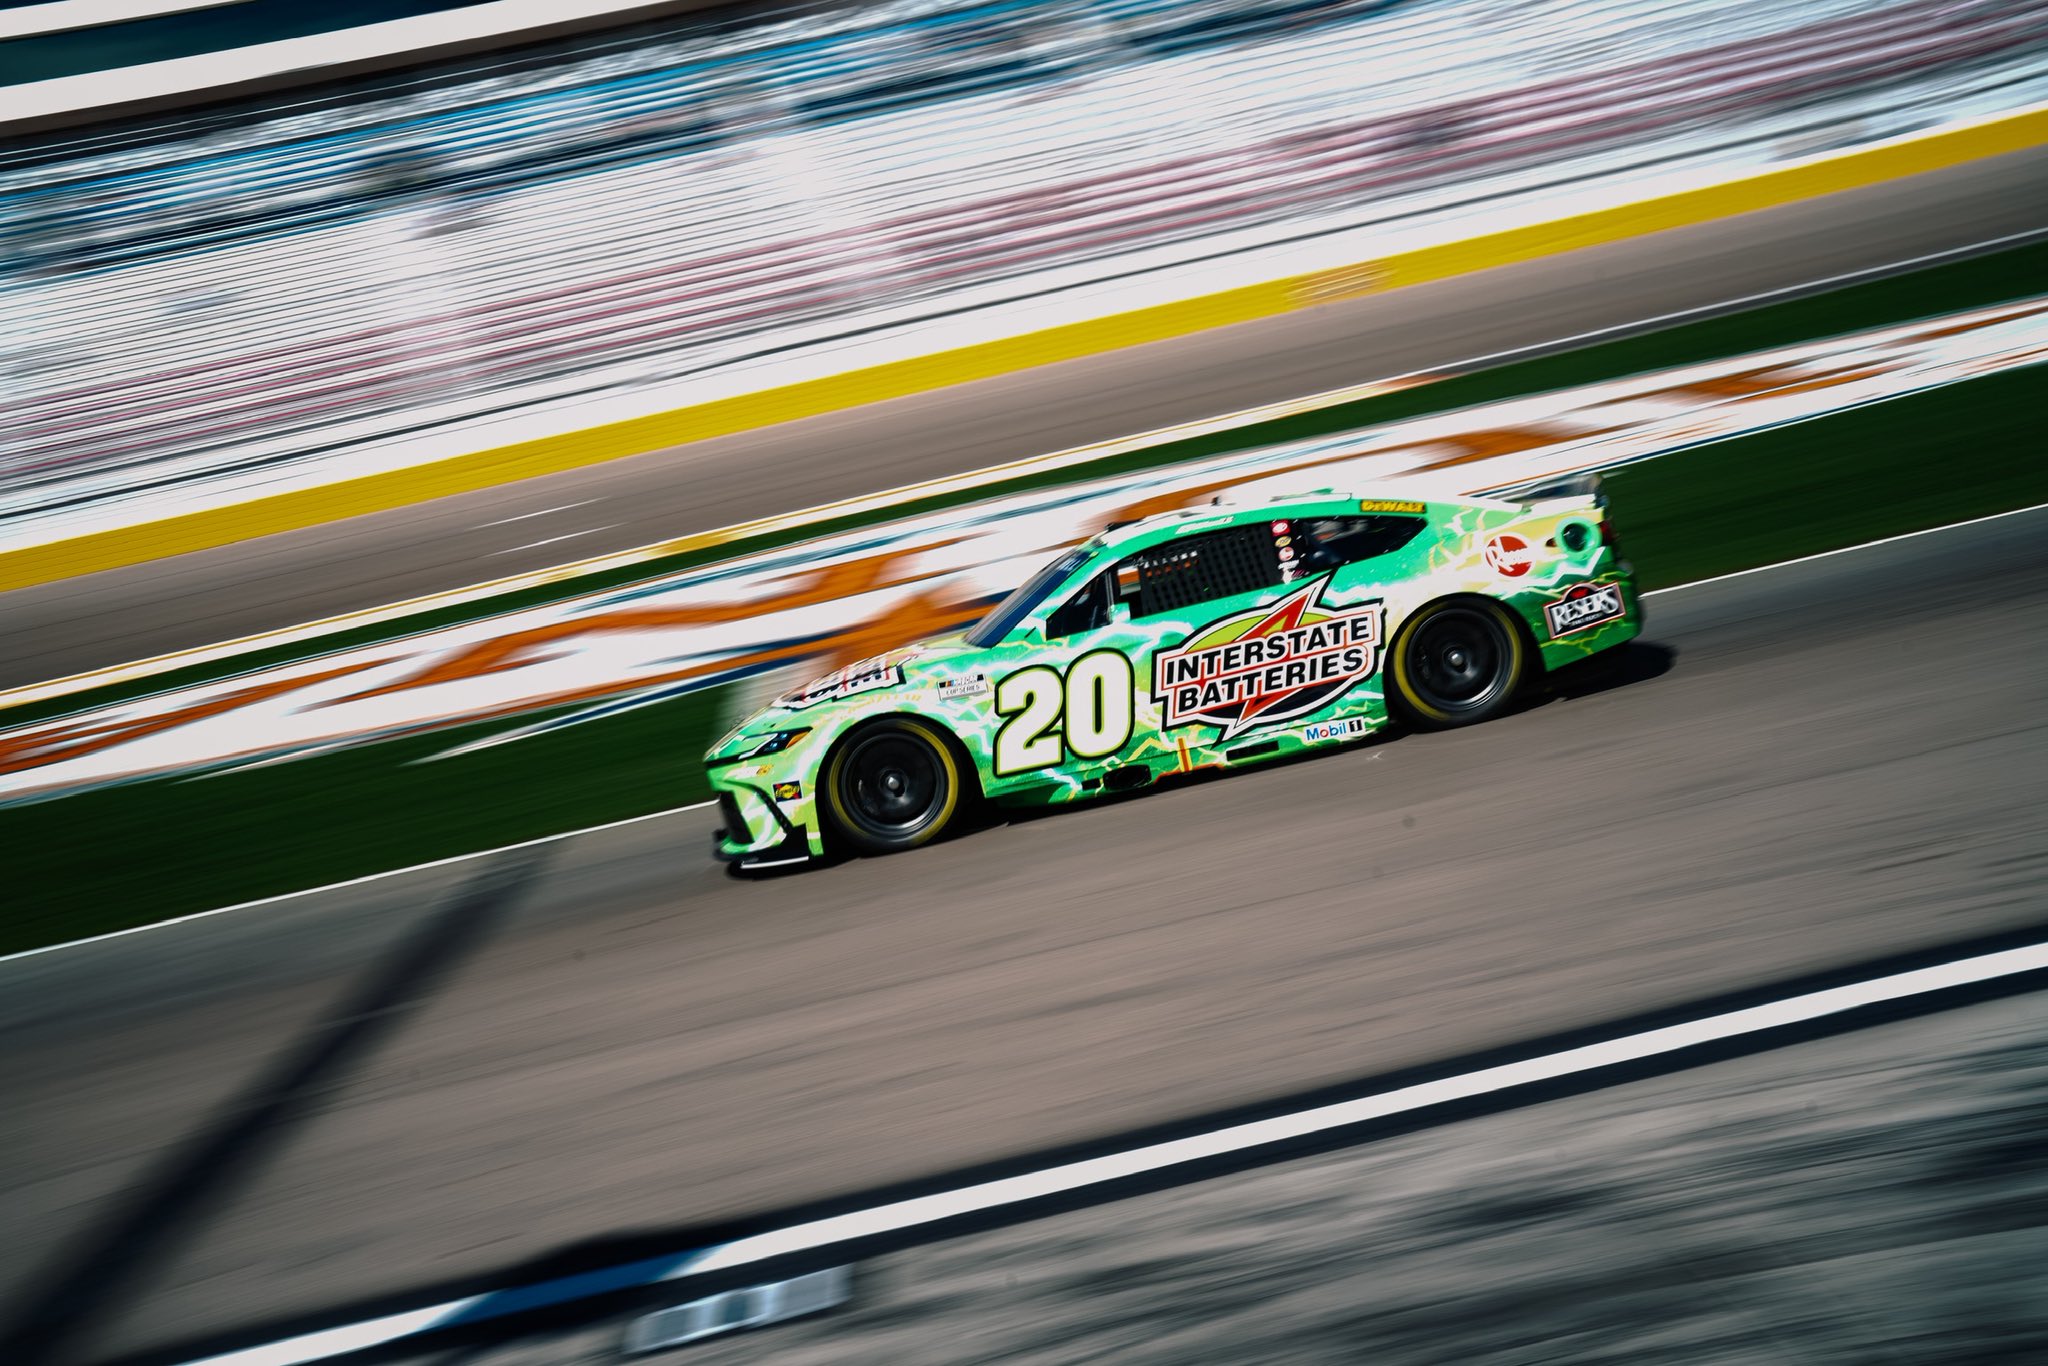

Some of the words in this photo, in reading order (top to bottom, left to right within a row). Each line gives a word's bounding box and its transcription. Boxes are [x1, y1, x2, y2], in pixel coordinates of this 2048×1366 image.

[1166, 616, 1370, 685] INTERSTATE
[1178, 648, 1363, 713] BATTERIES
[994, 648, 1134, 777] 20
[1306, 722, 1347, 740] Mobil
[1350, 720, 1361, 732] 1
